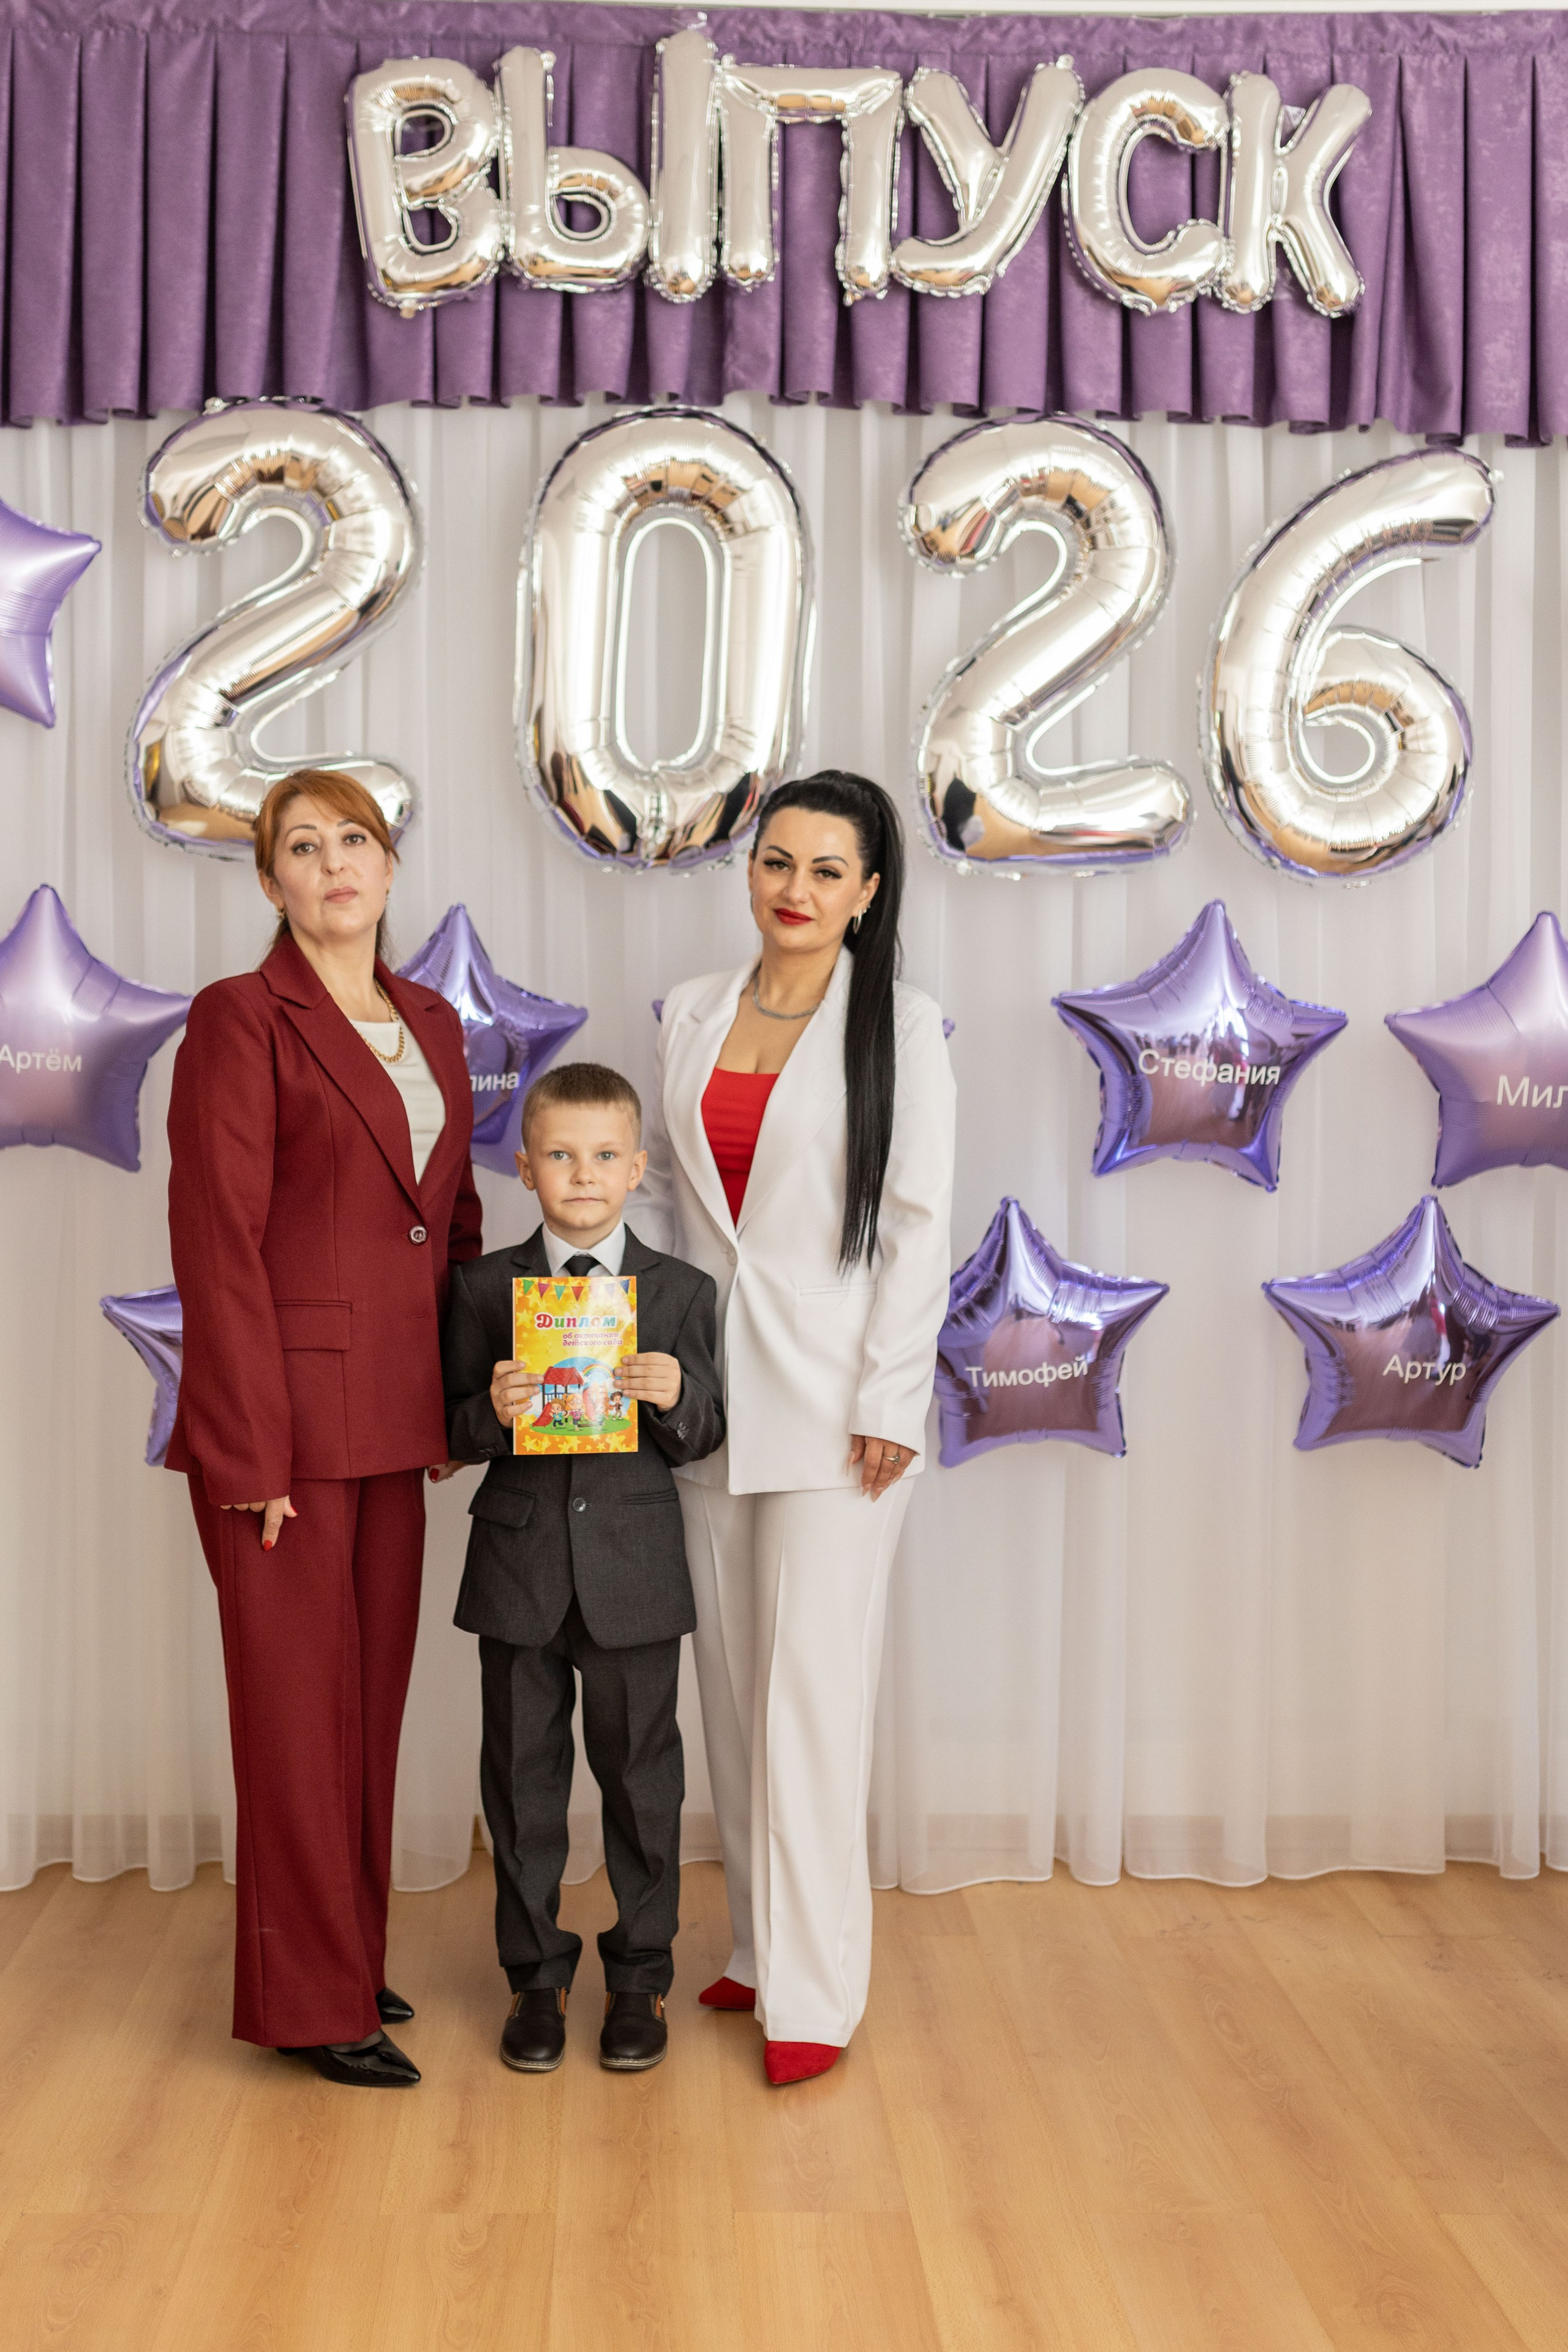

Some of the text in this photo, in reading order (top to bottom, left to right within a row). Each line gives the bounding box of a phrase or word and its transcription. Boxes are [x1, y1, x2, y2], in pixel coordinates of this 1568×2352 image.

[347, 27, 1373, 316] ВЫПУСК
[126, 398, 1501, 884] 2026
[0, 1044, 83, 1074] Артём
[1138, 1048, 1281, 1087] Стефания
[535, 1313, 616, 1329] Диплом
[965, 1354, 1088, 1388] Тимофей
[1382, 1354, 1466, 1386] Артур
